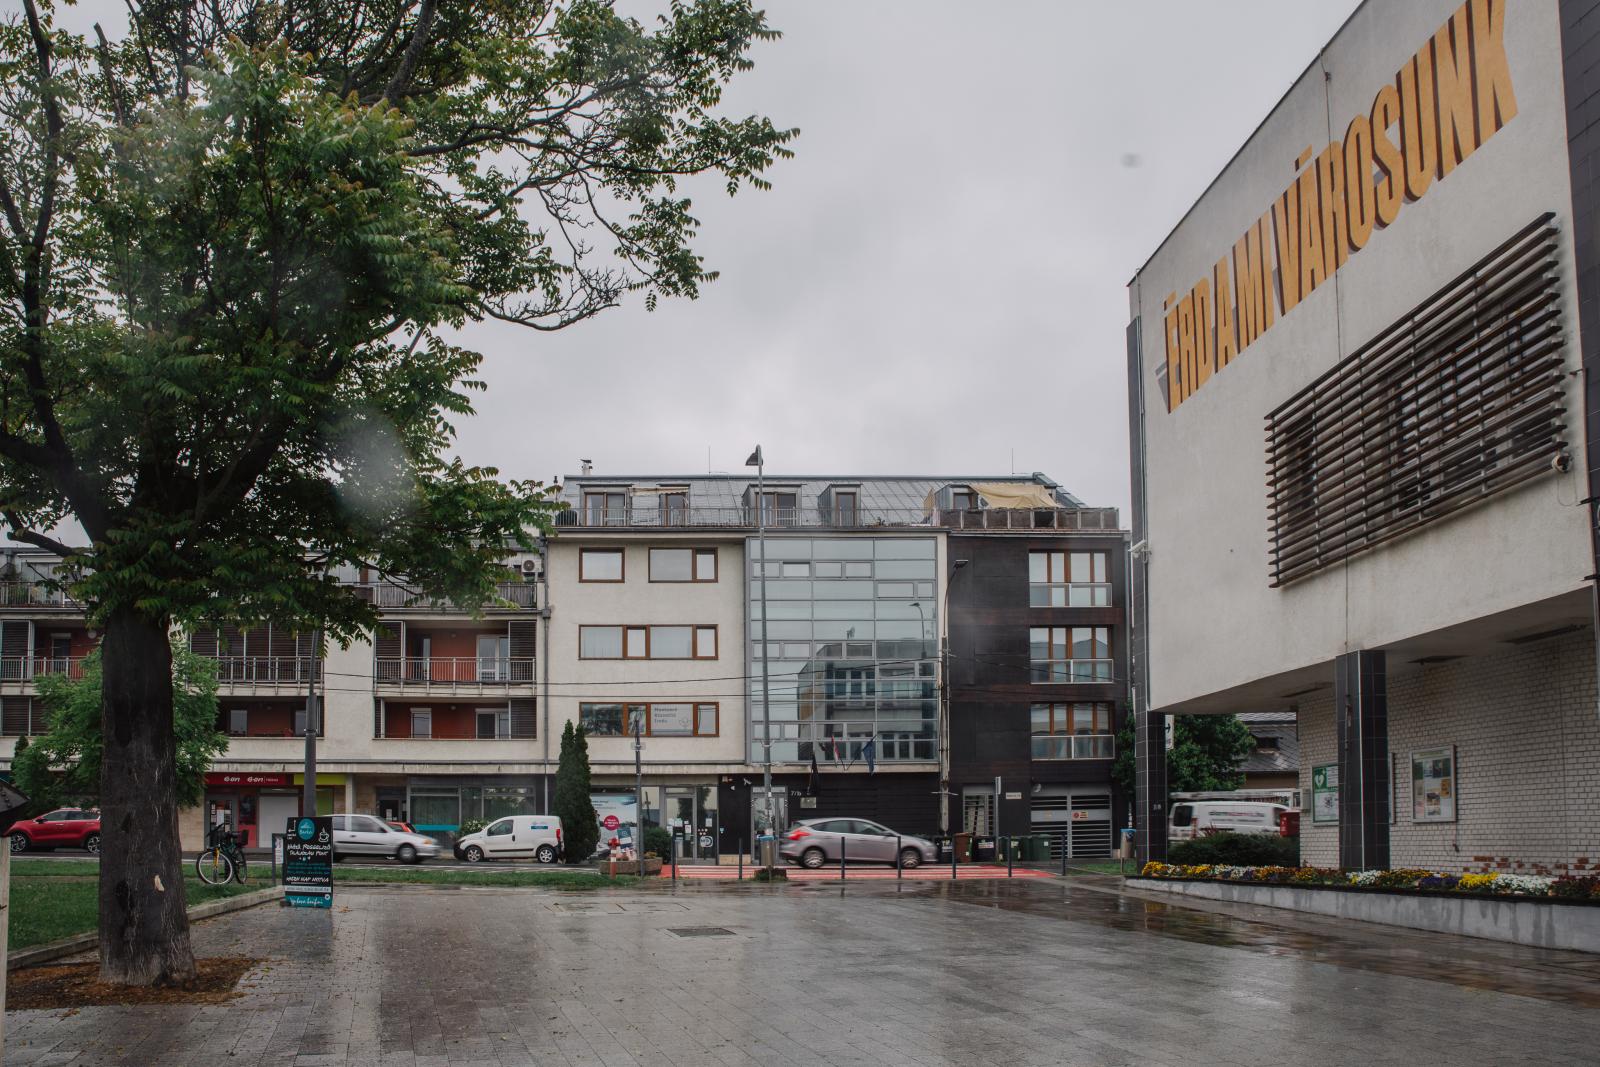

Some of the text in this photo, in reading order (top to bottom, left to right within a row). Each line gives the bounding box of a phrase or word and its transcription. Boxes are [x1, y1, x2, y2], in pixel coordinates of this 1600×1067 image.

[1164, 0, 1518, 414] ÉRD A MI VÁROSUNK
